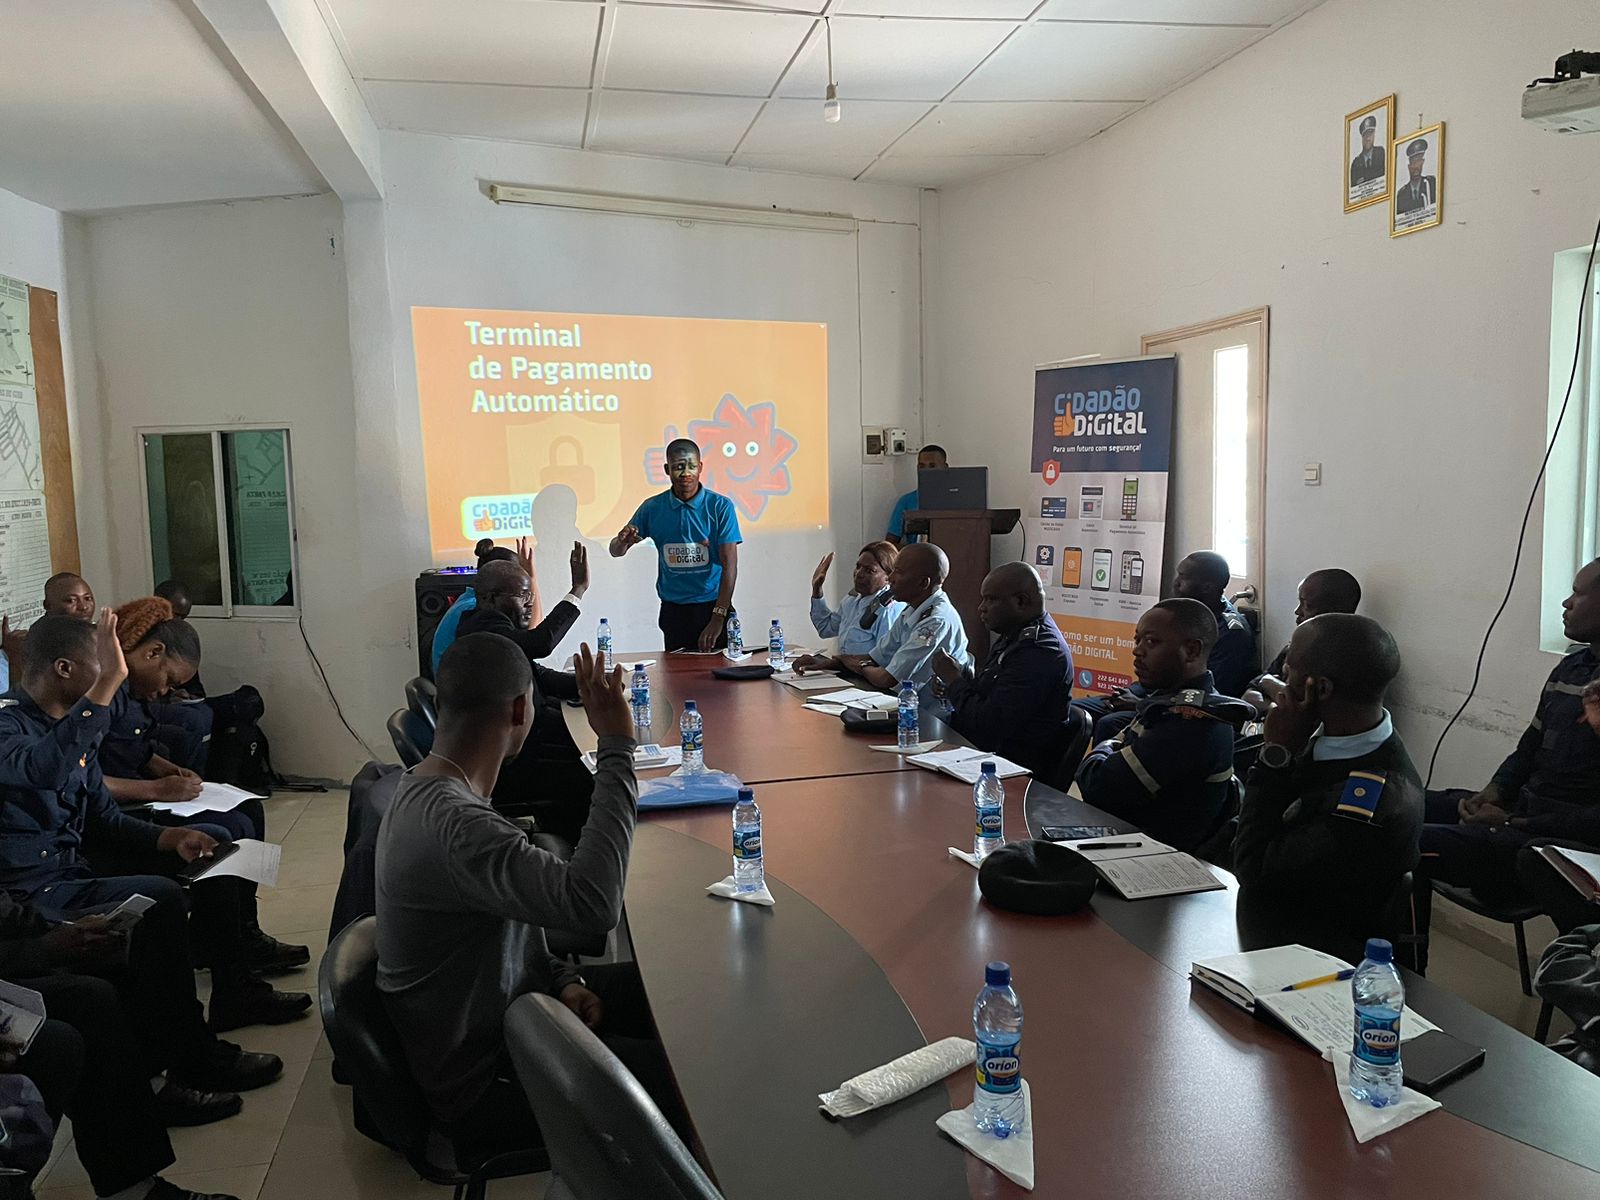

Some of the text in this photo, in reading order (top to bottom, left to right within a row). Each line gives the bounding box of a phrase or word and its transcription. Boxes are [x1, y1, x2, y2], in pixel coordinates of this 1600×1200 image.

[464, 320, 581, 347] Terminal
[468, 354, 652, 385] de Pagamento
[471, 387, 619, 413] Automático
[1076, 444, 1095, 452] futuro
[1109, 444, 1142, 453] segurança!
[1084, 634, 1097, 642] ser
[1099, 635, 1114, 645] um
[1116, 635, 1137, 649] bom
[1084, 646, 1119, 660] DIGITAL.
[1364, 1032, 1396, 1042] orion
[987, 1060, 1017, 1071] orion
